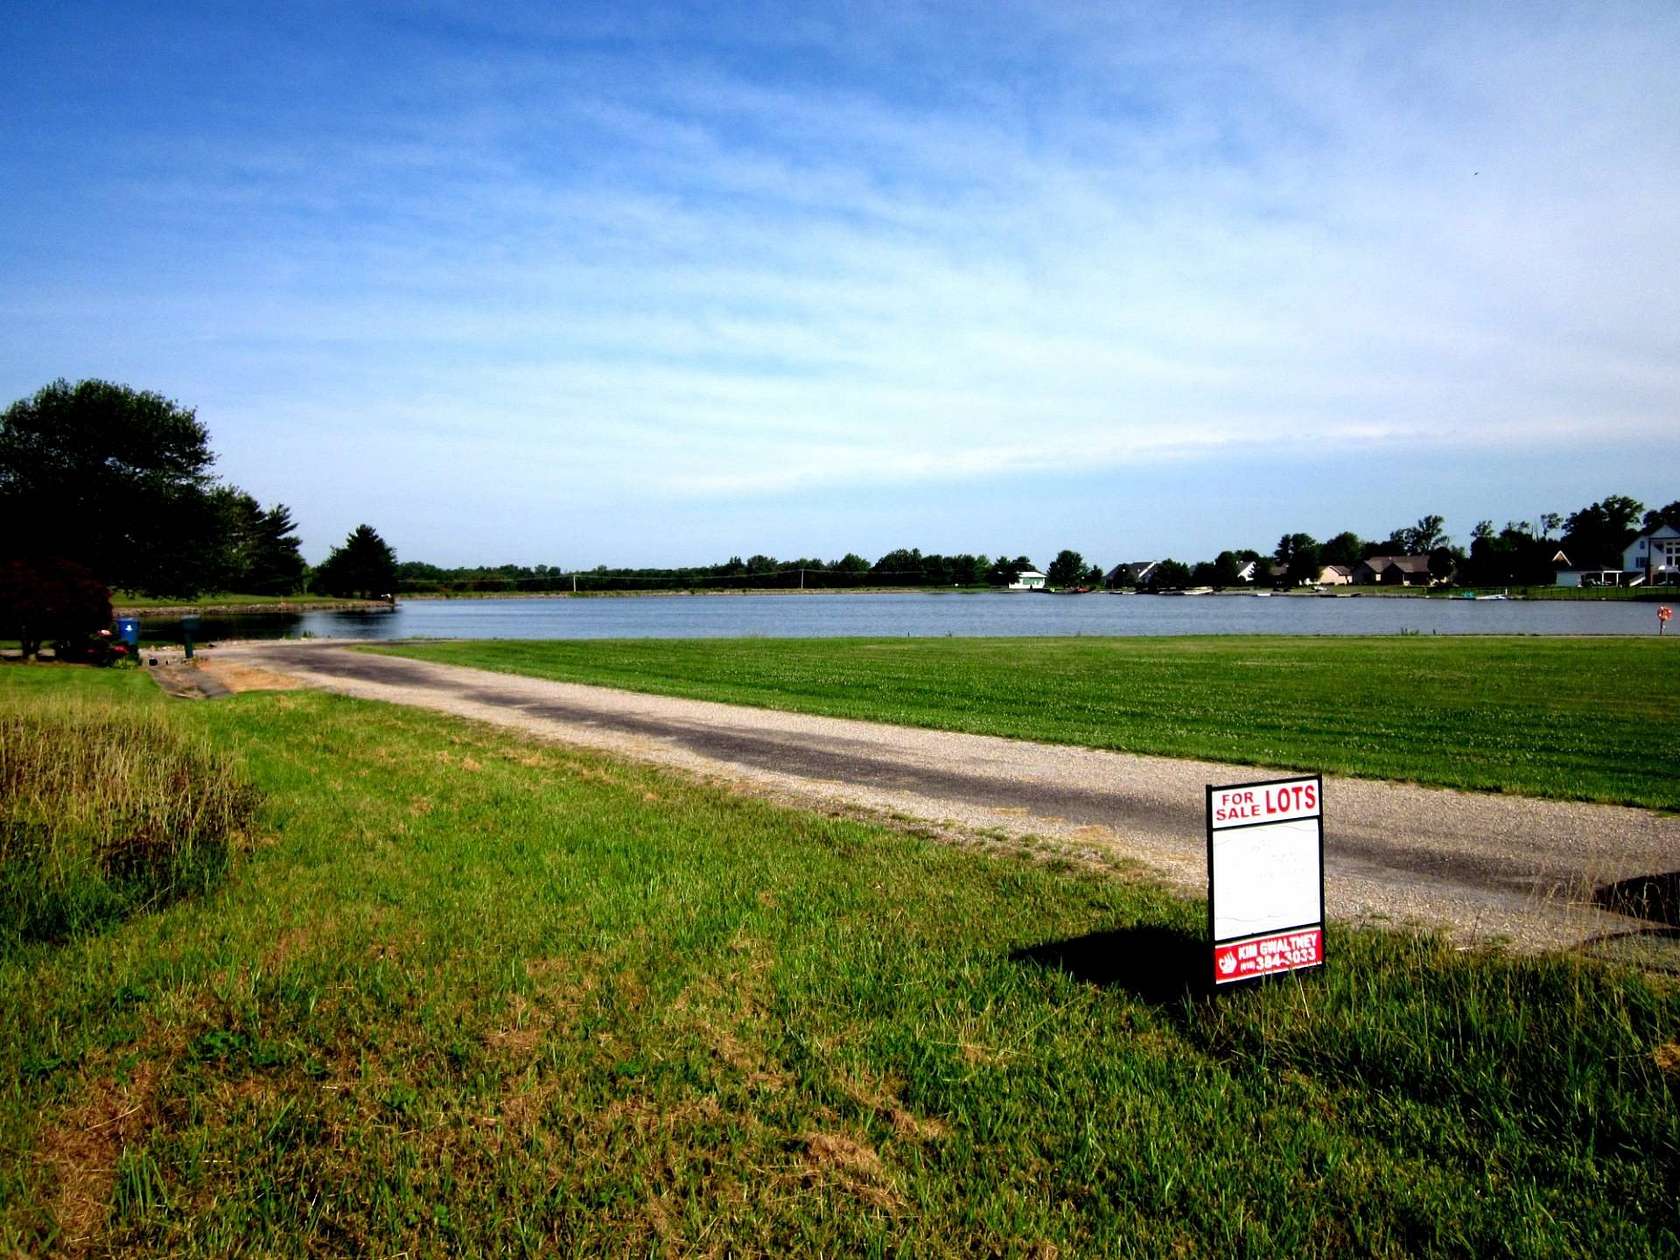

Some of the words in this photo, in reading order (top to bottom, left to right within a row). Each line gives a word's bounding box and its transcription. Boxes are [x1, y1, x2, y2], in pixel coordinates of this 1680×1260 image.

[1222, 791, 1254, 806] FOR
[1265, 785, 1316, 814] LOTS
[1216, 804, 1261, 821] SALE
